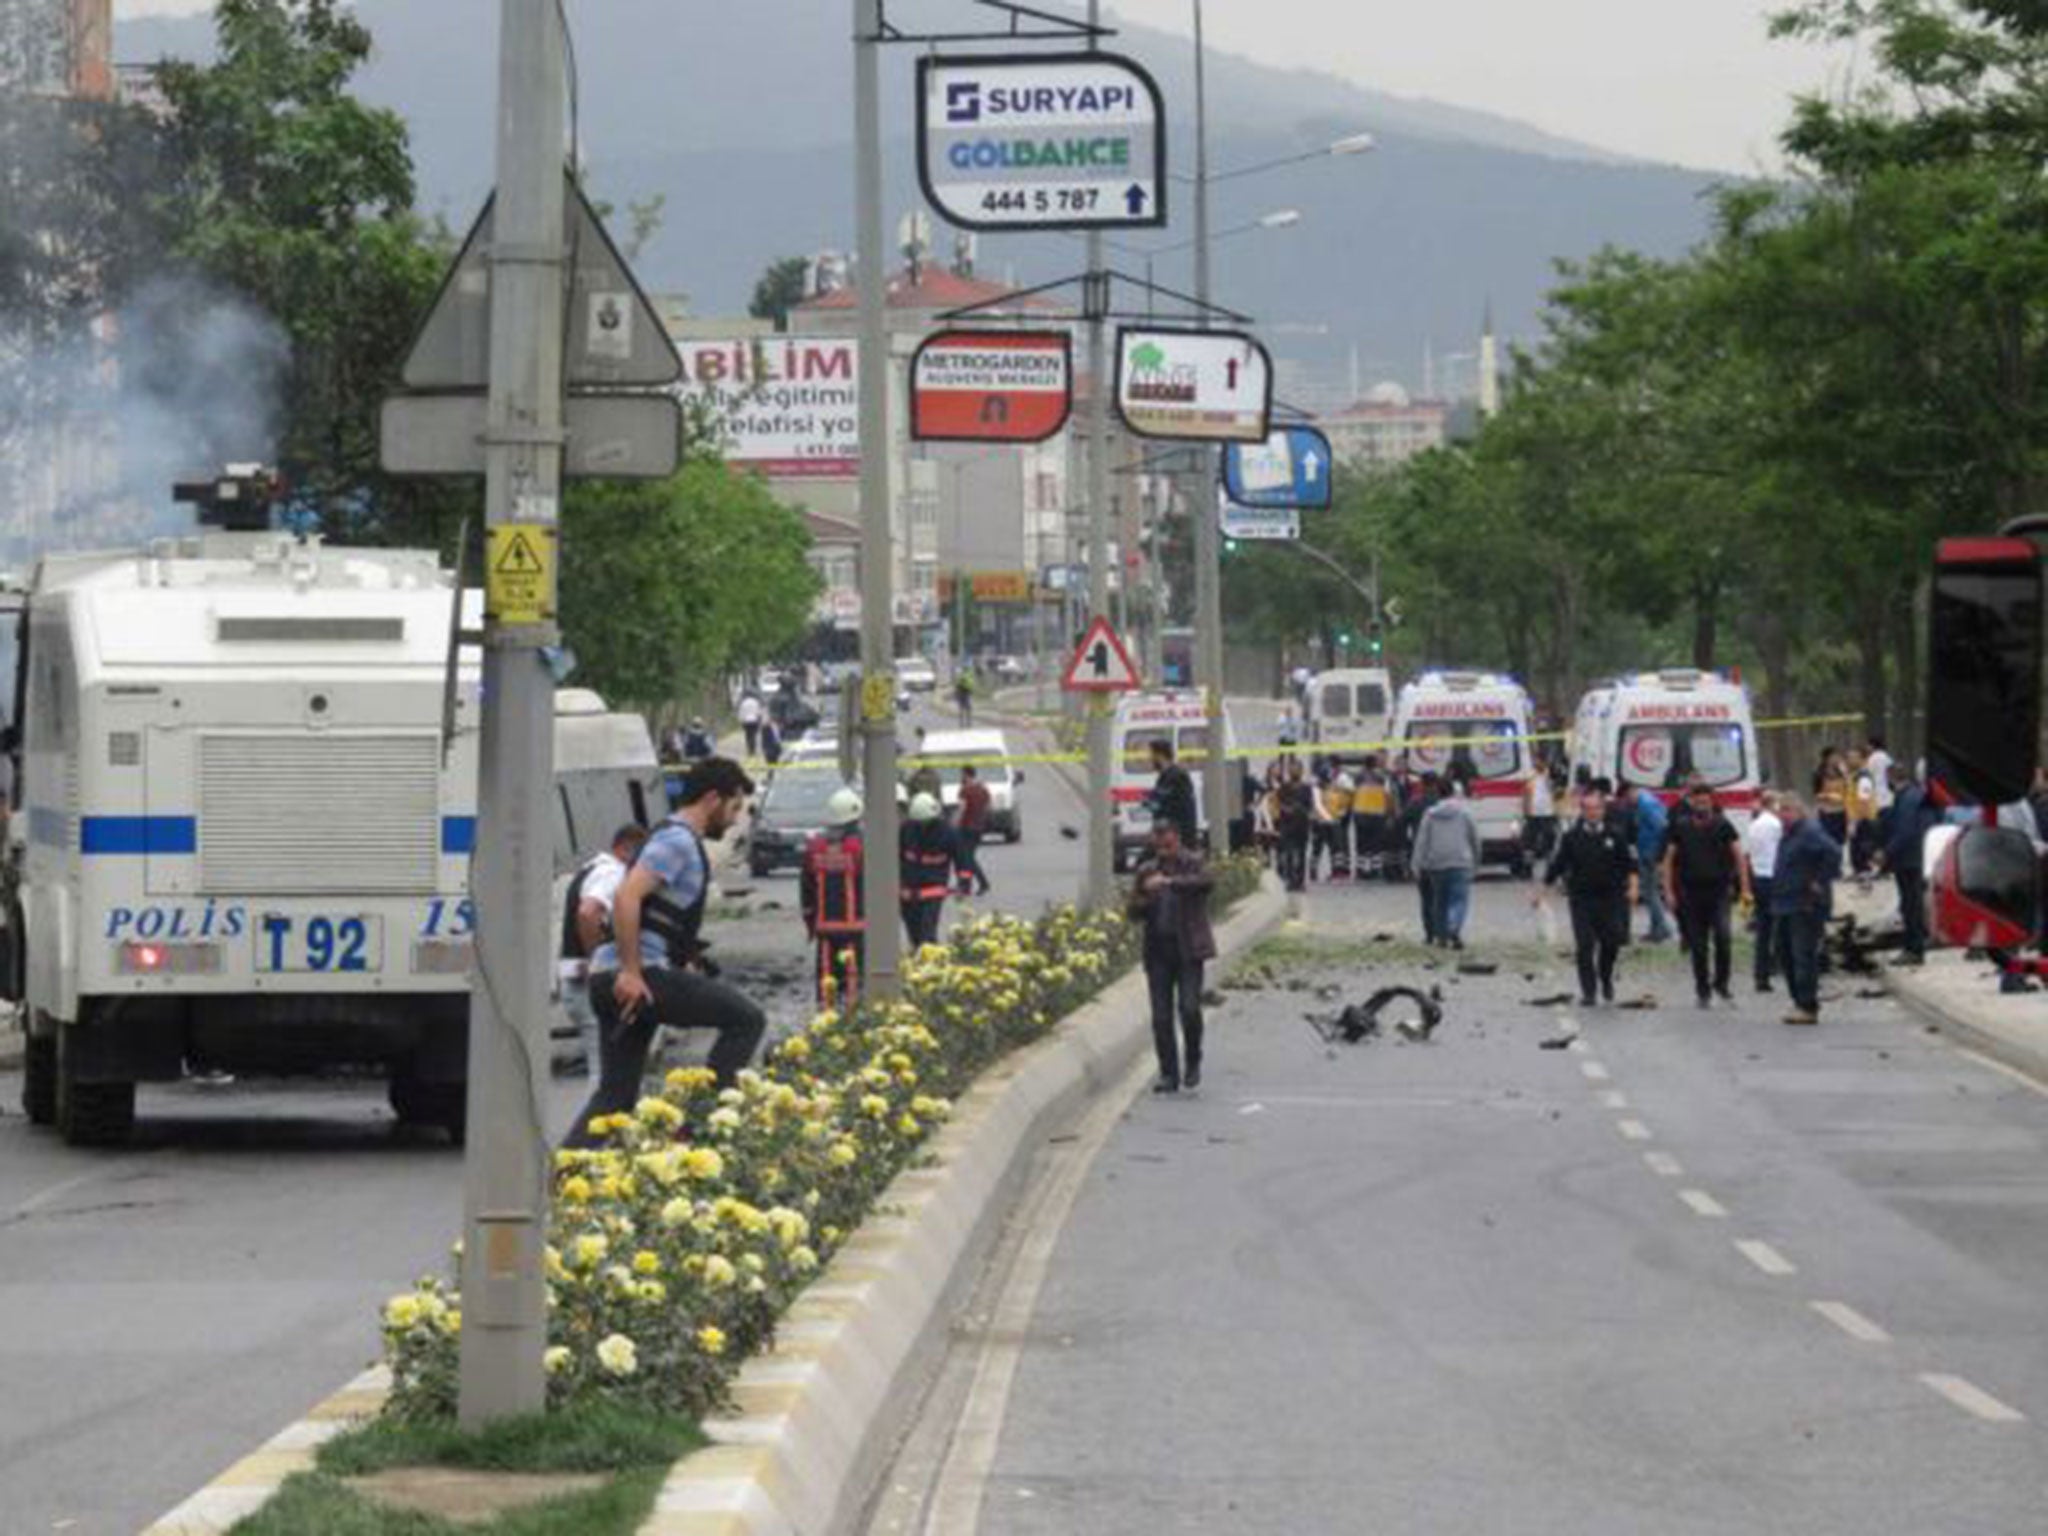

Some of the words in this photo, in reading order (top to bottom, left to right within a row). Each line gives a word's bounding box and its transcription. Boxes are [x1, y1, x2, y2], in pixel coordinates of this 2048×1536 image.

[987, 86, 1133, 113] SURYAPI
[981, 190, 1026, 211] 444
[1034, 190, 1049, 211] 5
[1057, 188, 1099, 211] 787
[682, 340, 852, 382] BİLİM
[1411, 702, 1505, 718] AMBULANS
[1627, 703, 1731, 718] AMBULANS
[106, 898, 246, 939] POLİS
[263, 915, 292, 971] T
[306, 916, 367, 971] 92
